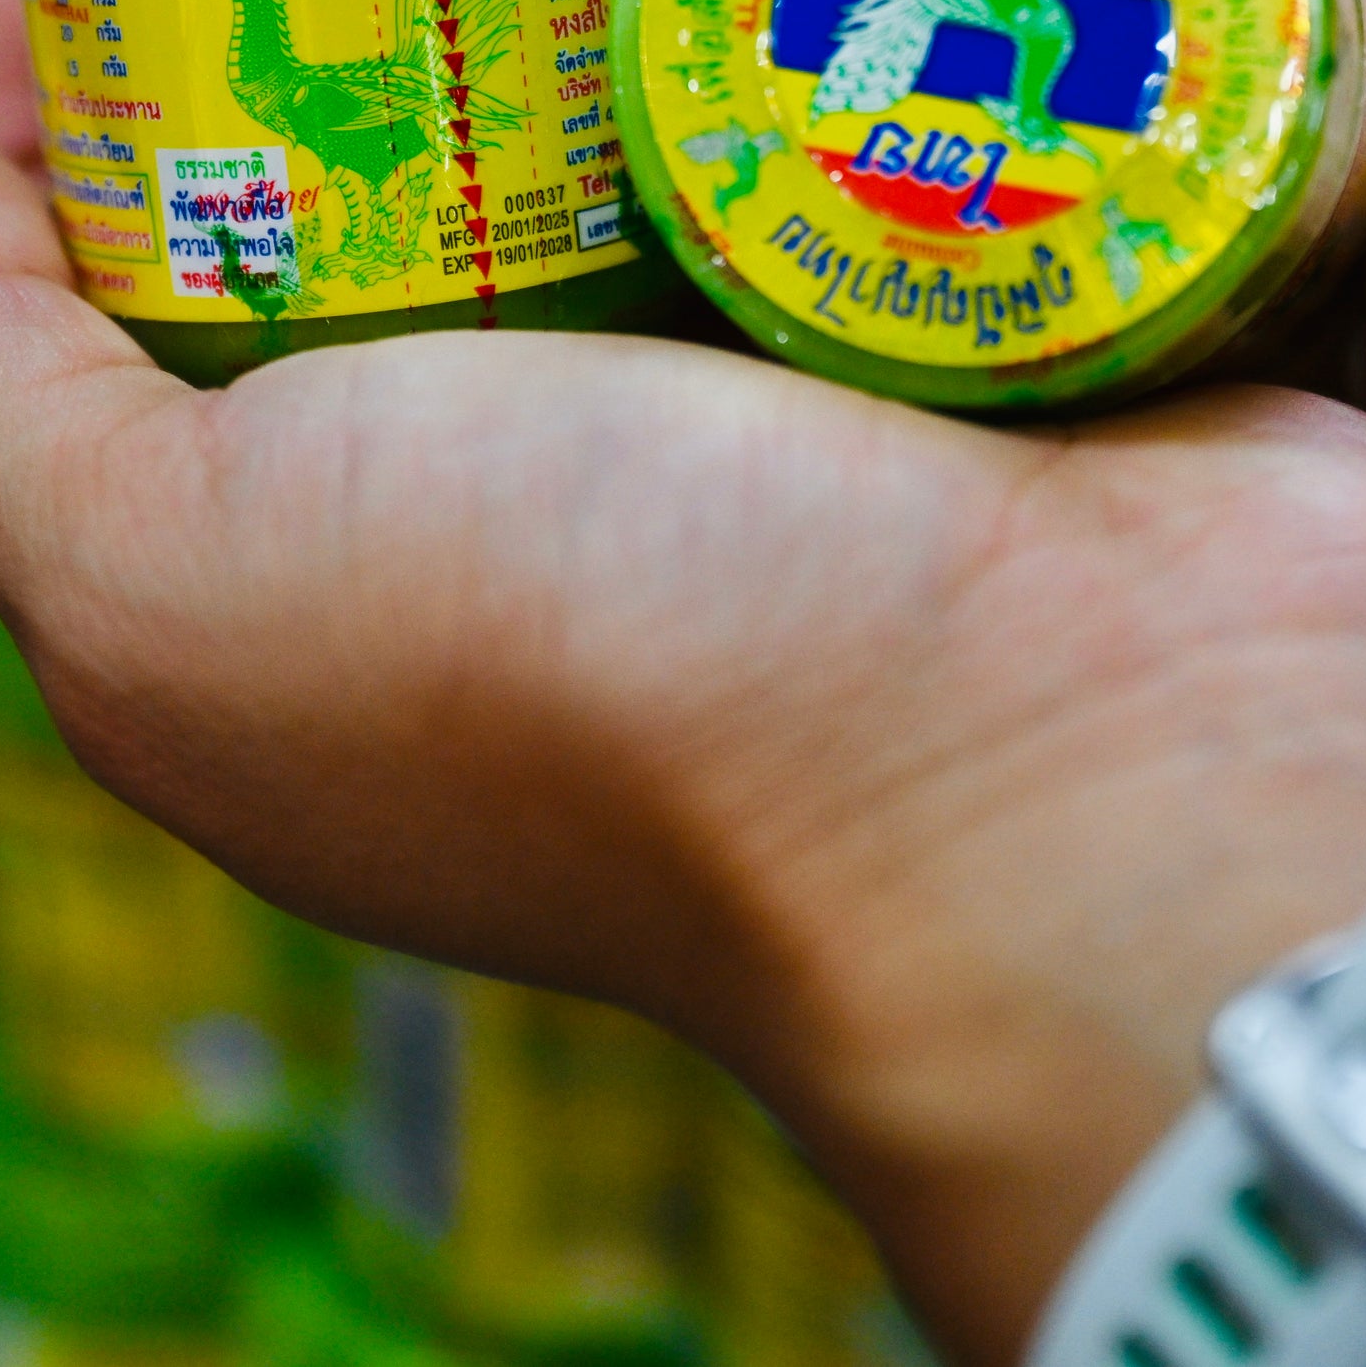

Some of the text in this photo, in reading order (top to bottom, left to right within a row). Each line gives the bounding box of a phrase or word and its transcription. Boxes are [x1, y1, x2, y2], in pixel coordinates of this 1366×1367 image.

[97, 19, 122, 43] กรัม
[102, 55, 128, 78] กรัม
[175, 151, 266, 180] ธรรมชาติ
[849, 121, 1008, 233] ไทย
[437, 203, 468, 226] LOT
[440, 210, 570, 251] MFG 20/01/2025
[442, 234, 573, 276] EXP 19/01/2028
[767, 212, 1076, 348] ภูมิปัญญาไทย
